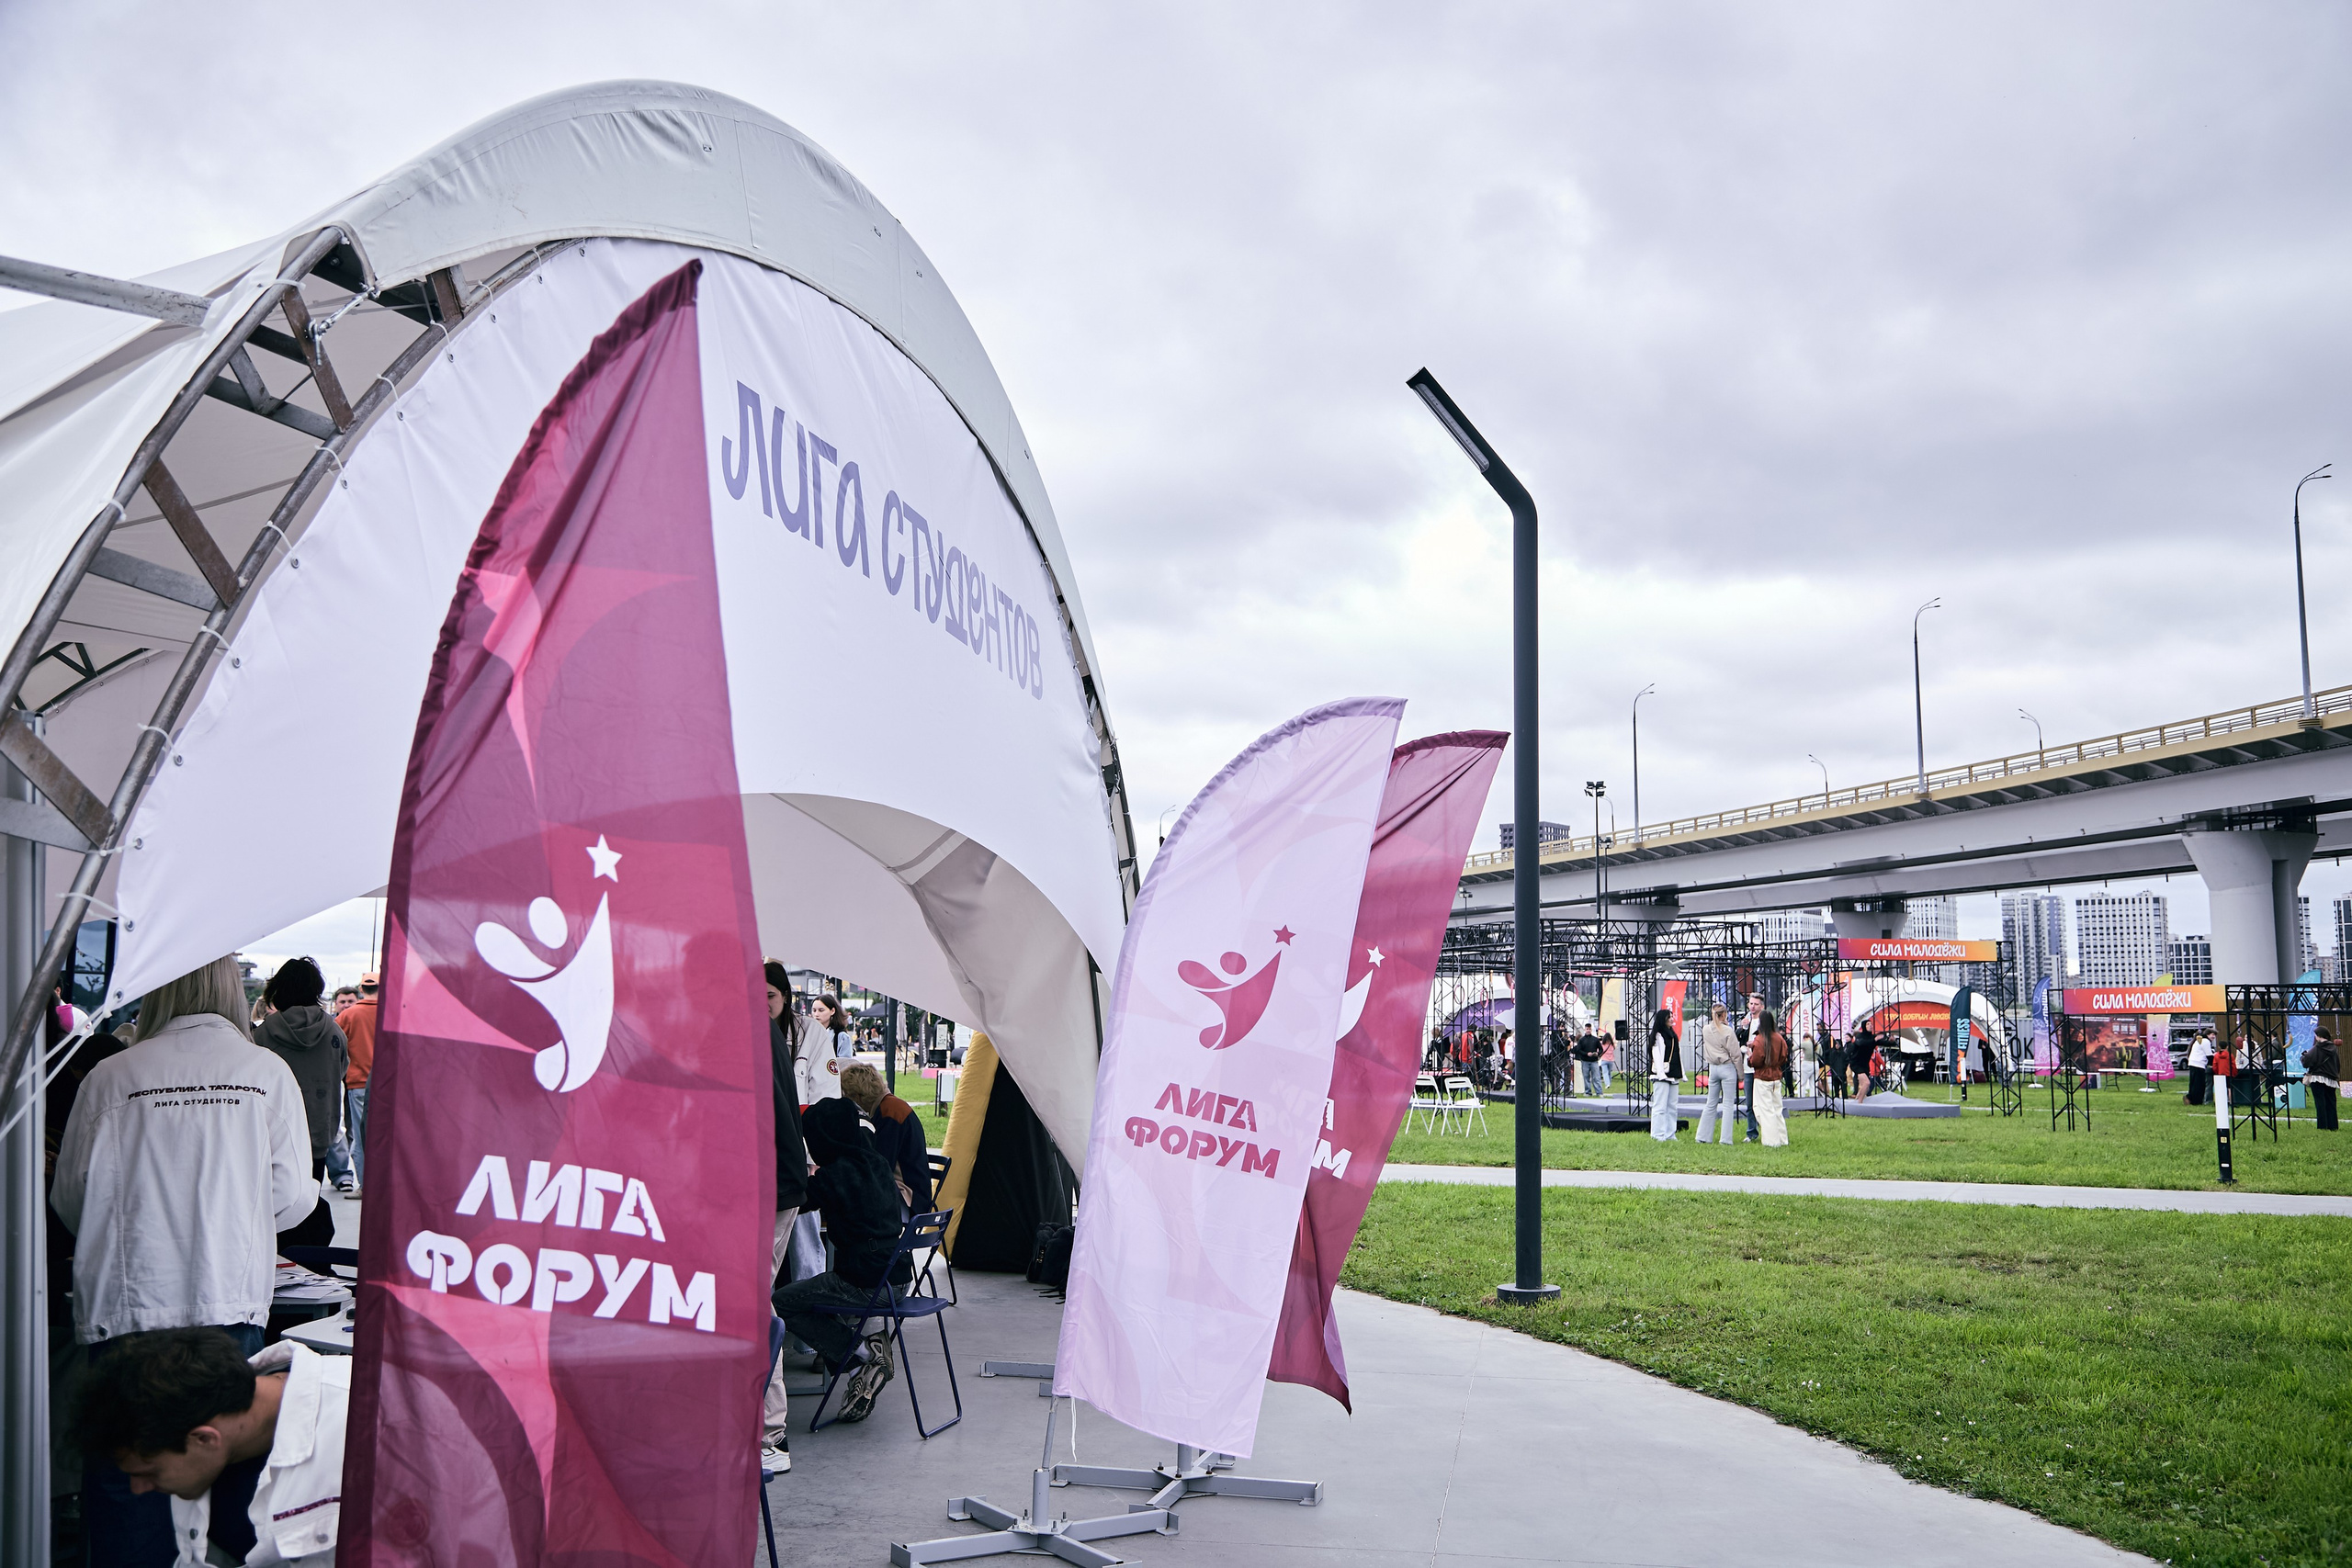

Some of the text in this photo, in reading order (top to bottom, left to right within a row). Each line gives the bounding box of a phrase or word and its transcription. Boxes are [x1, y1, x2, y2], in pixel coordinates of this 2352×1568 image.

[1956, 1018, 1971, 1050] FITNESS
[128, 1084, 267, 1100] РЕСПУБЛИКА ТАТАРСТАН
[153, 1098, 241, 1108] ЛИГА СТУДЕНТОВ
[1154, 1082, 1257, 1133] ЛИГА
[1125, 1115, 1281, 1179] ФОРУМ
[455, 1154, 666, 1243] ЛИГА
[406, 1229, 716, 1333] ФОРУМ
